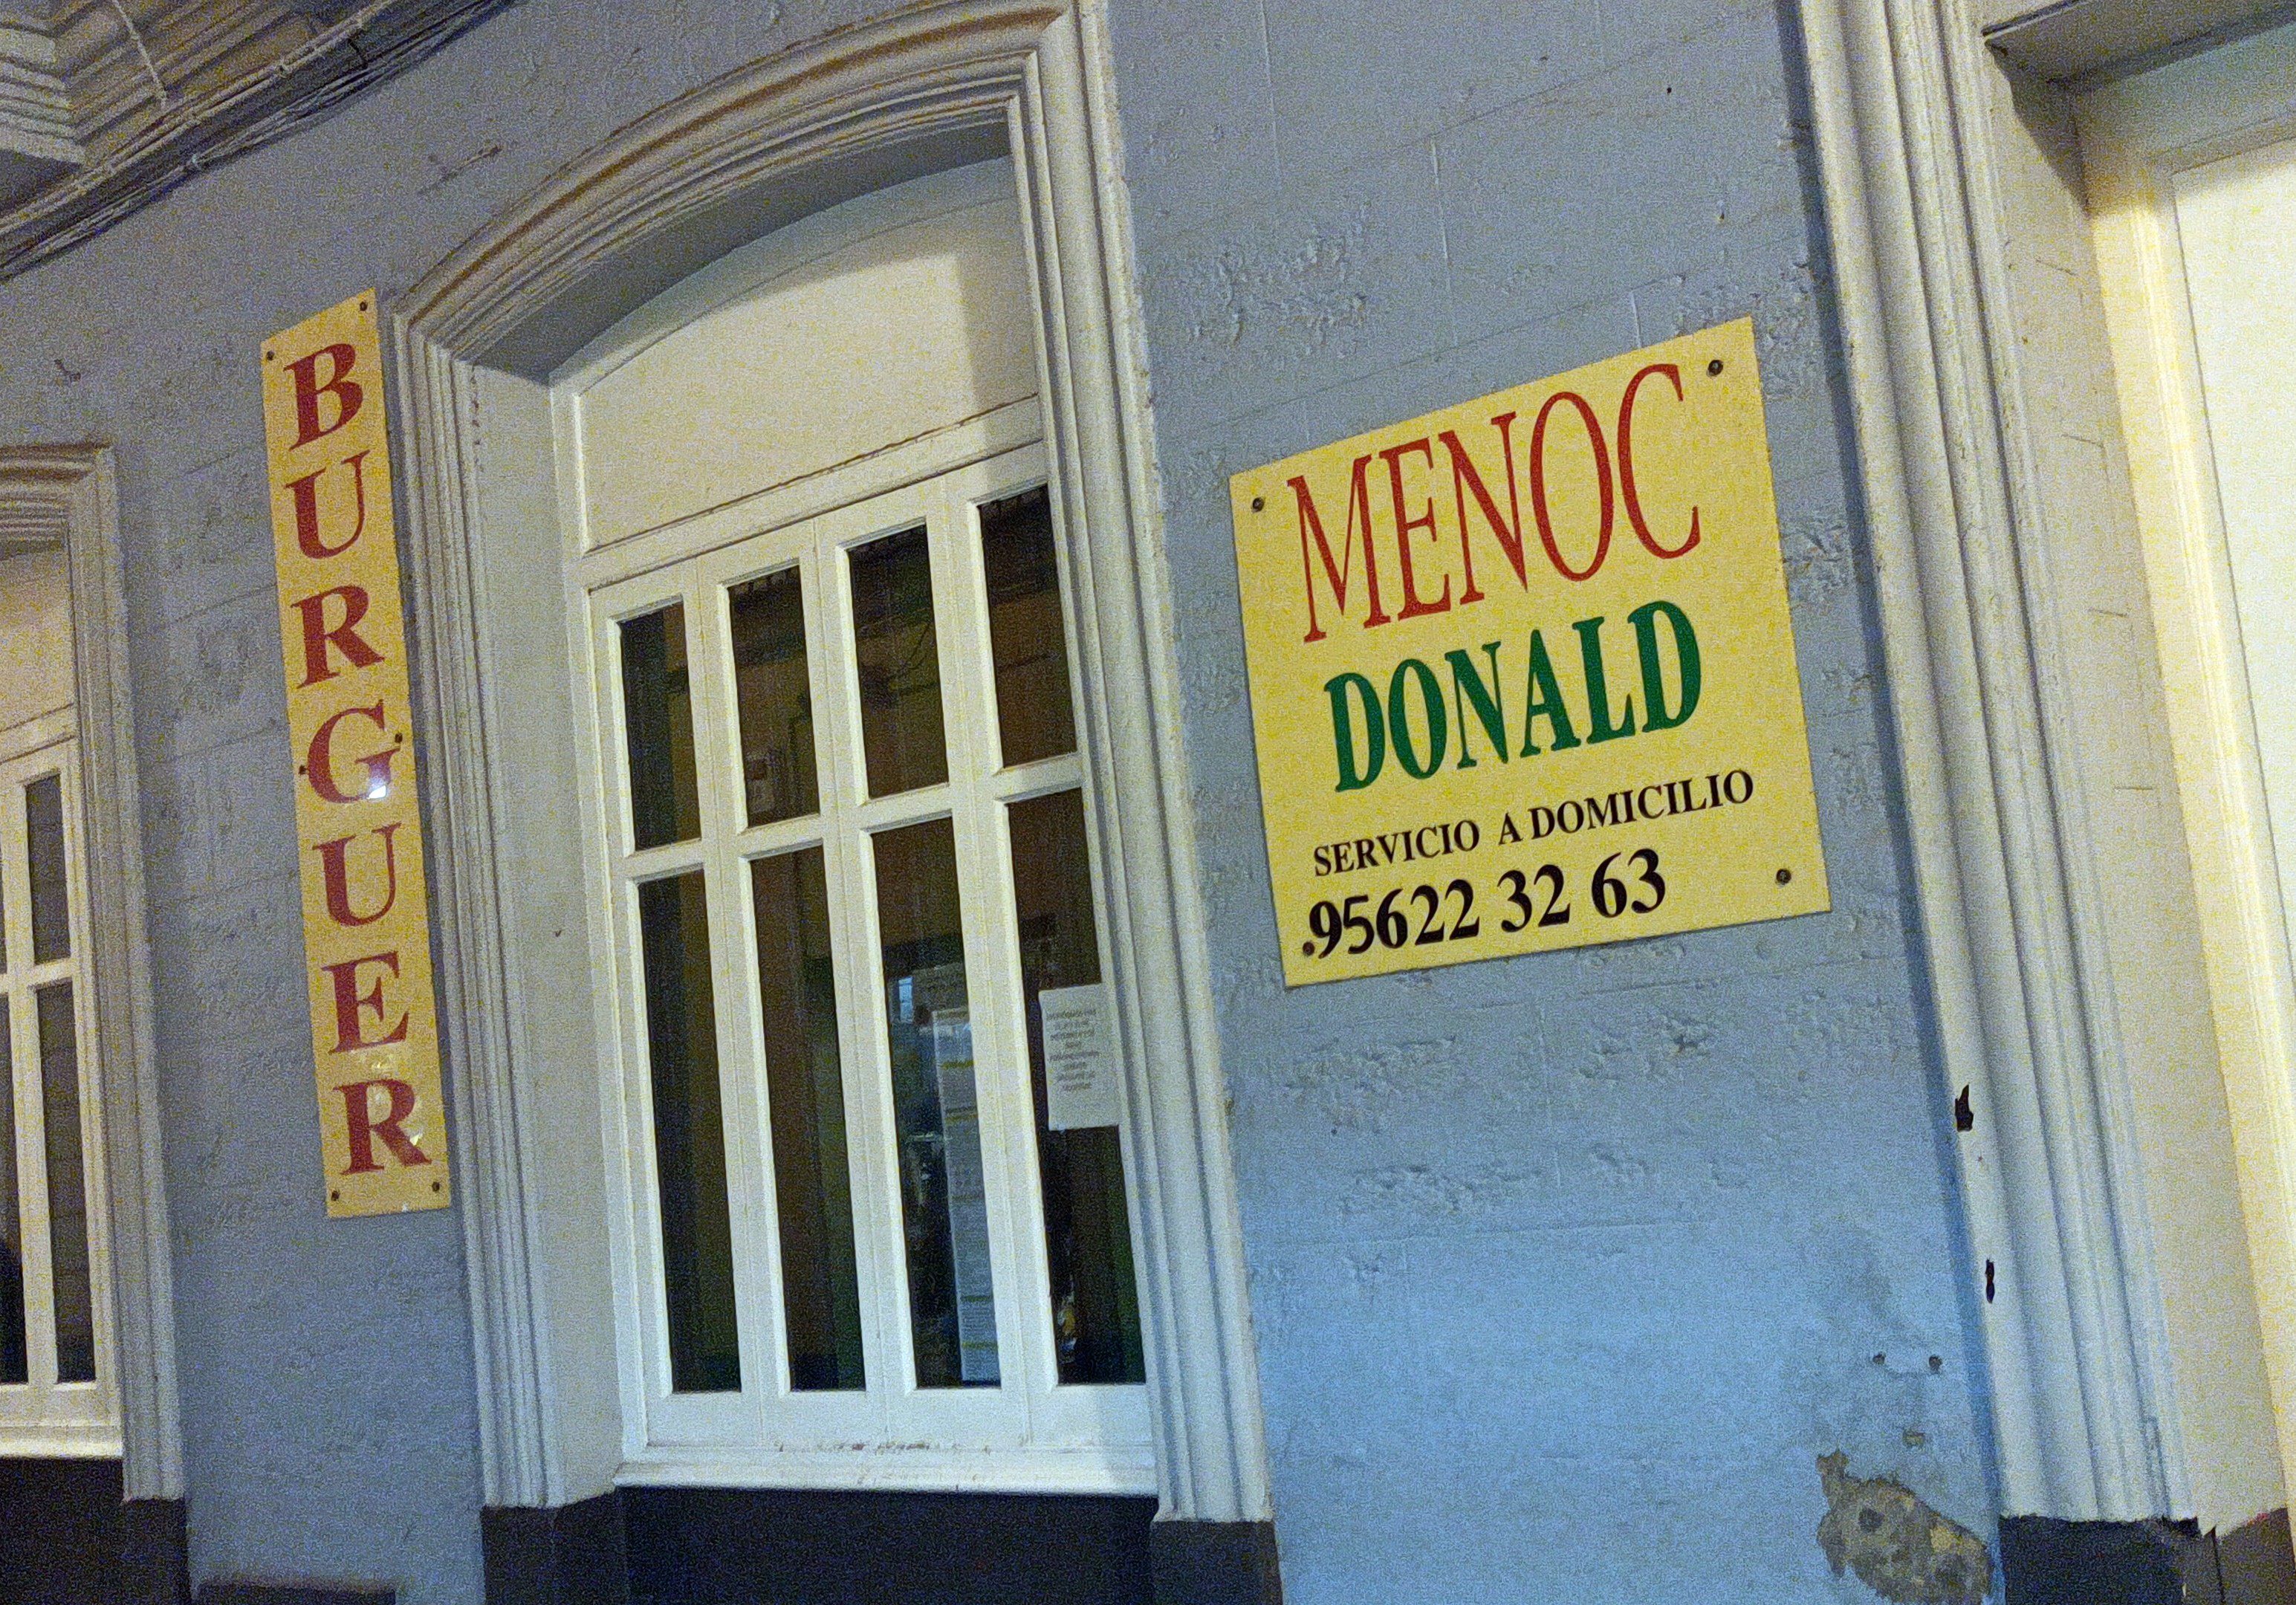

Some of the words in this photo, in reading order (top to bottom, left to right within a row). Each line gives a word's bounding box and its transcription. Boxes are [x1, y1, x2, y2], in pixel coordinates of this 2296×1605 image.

[1286, 363, 1702, 643] MENOC
[283, 343, 432, 1175] BURGUER
[1323, 599, 1702, 793] DONALD
[1309, 879, 1480, 959] 95622
[1496, 863, 1571, 933] 32
[1591, 848, 1666, 918] 63
[1313, 820, 1480, 877] SERVICIO
[1498, 813, 1522, 845] A
[1528, 768, 1754, 839] DOMICILIO
